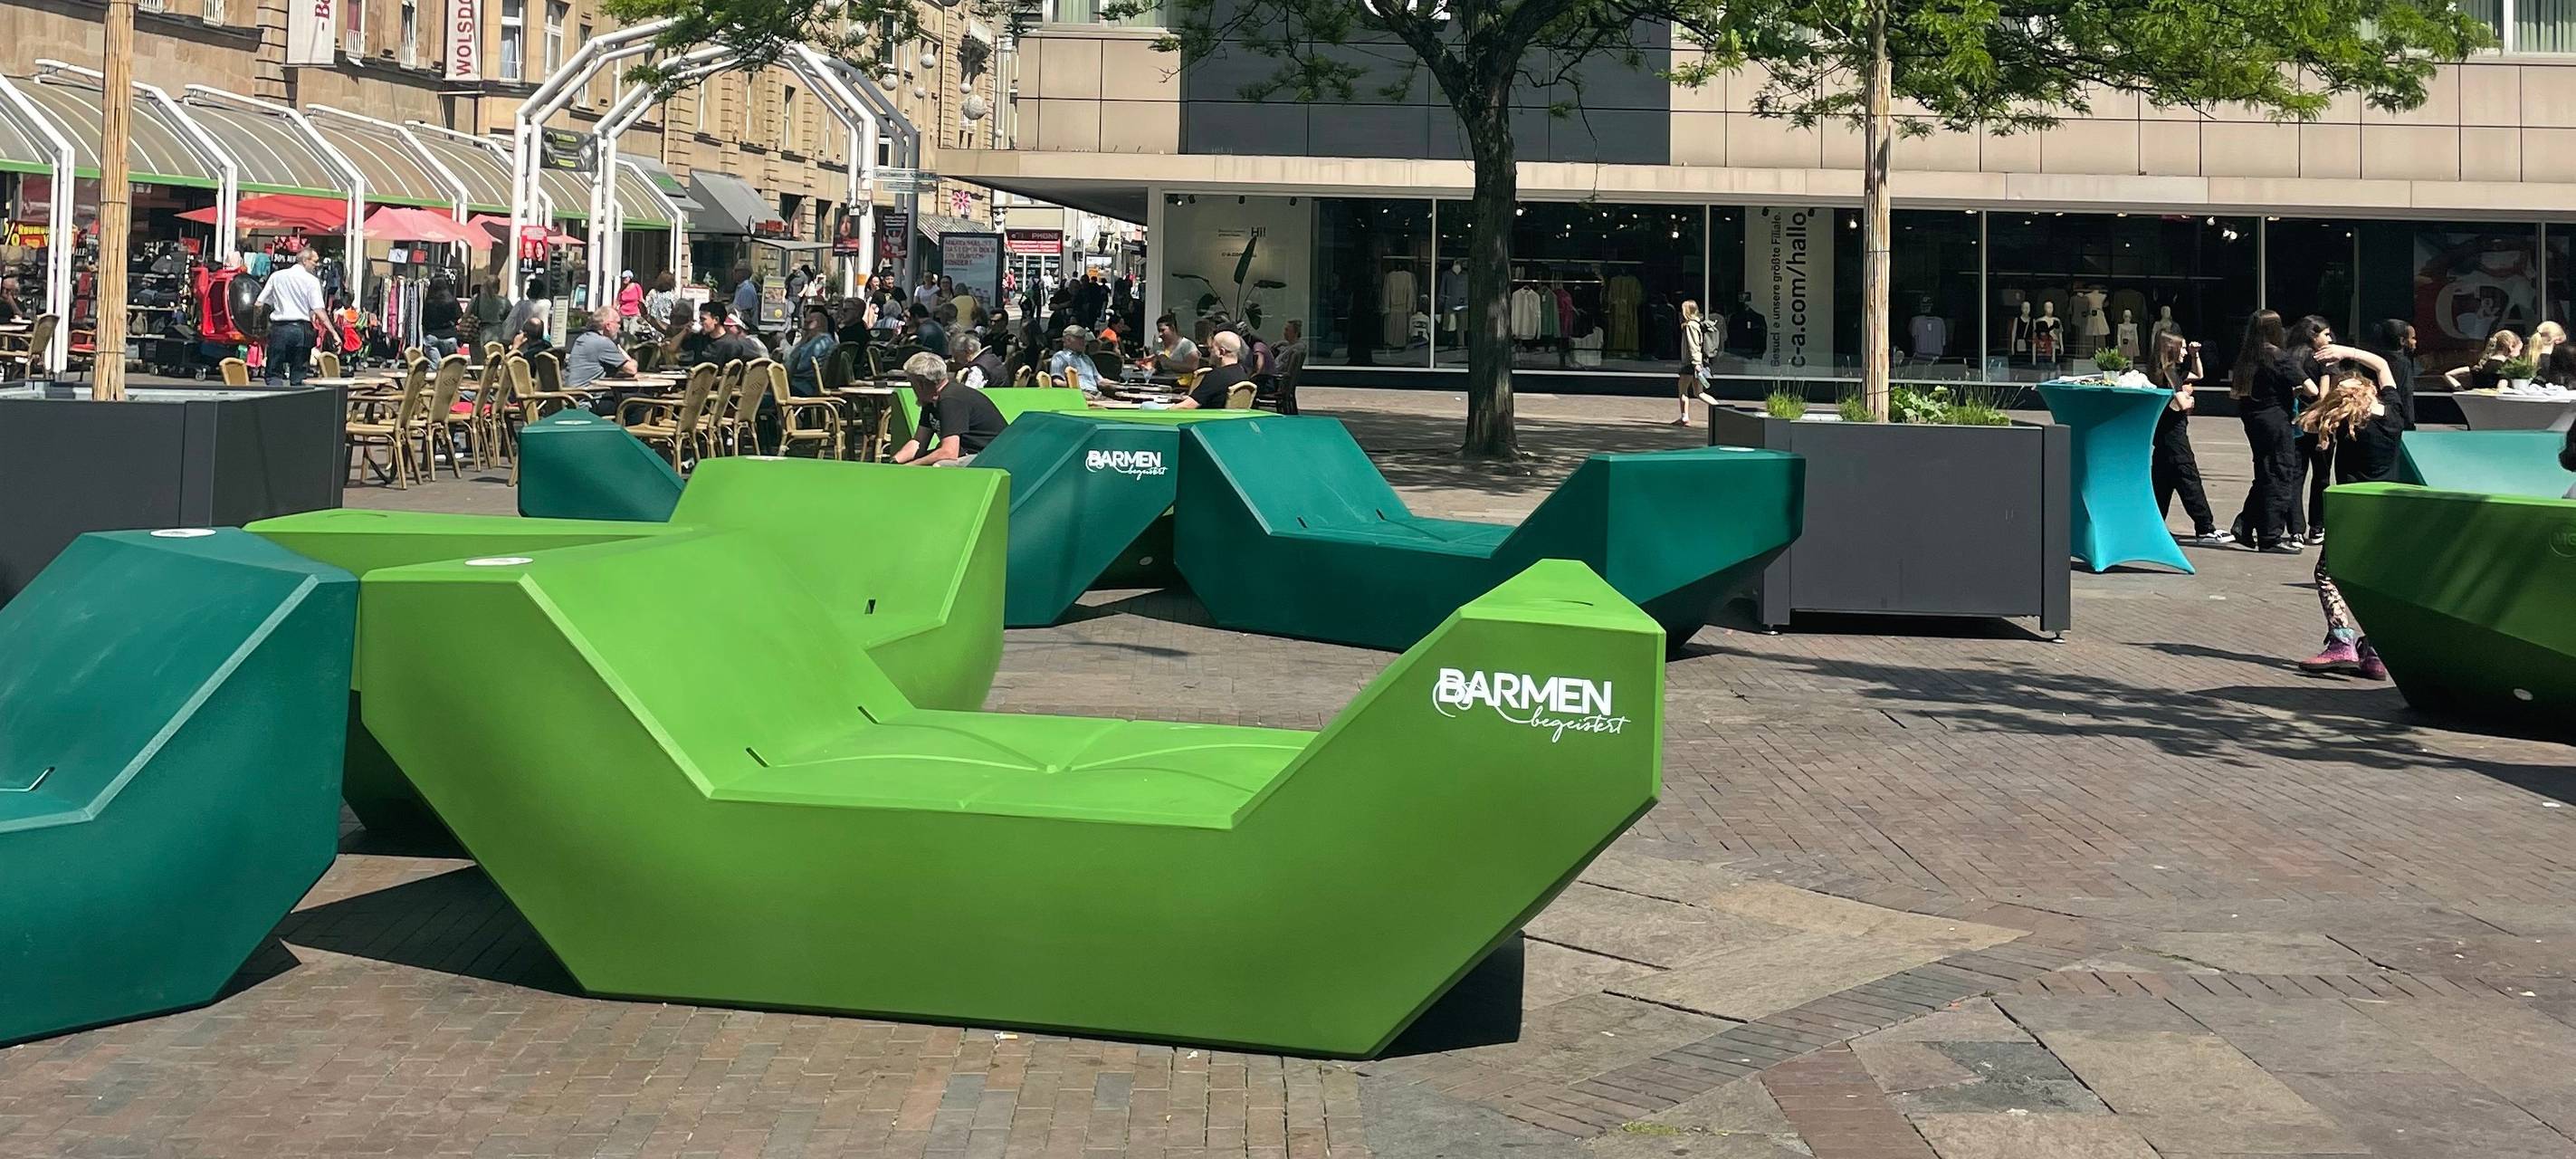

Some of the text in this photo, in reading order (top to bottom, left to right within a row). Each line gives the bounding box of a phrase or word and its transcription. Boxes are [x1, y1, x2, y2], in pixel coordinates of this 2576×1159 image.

[1770, 212, 1781, 244] Filiale.
[1770, 248, 1782, 283] größte
[1772, 286, 1781, 321] unsere
[1786, 212, 1807, 368] c-a.com/hallo
[1088, 450, 1162, 467] BARMEN
[1438, 667, 1612, 716] BARMEN
[1521, 704, 1631, 743] begeistert
